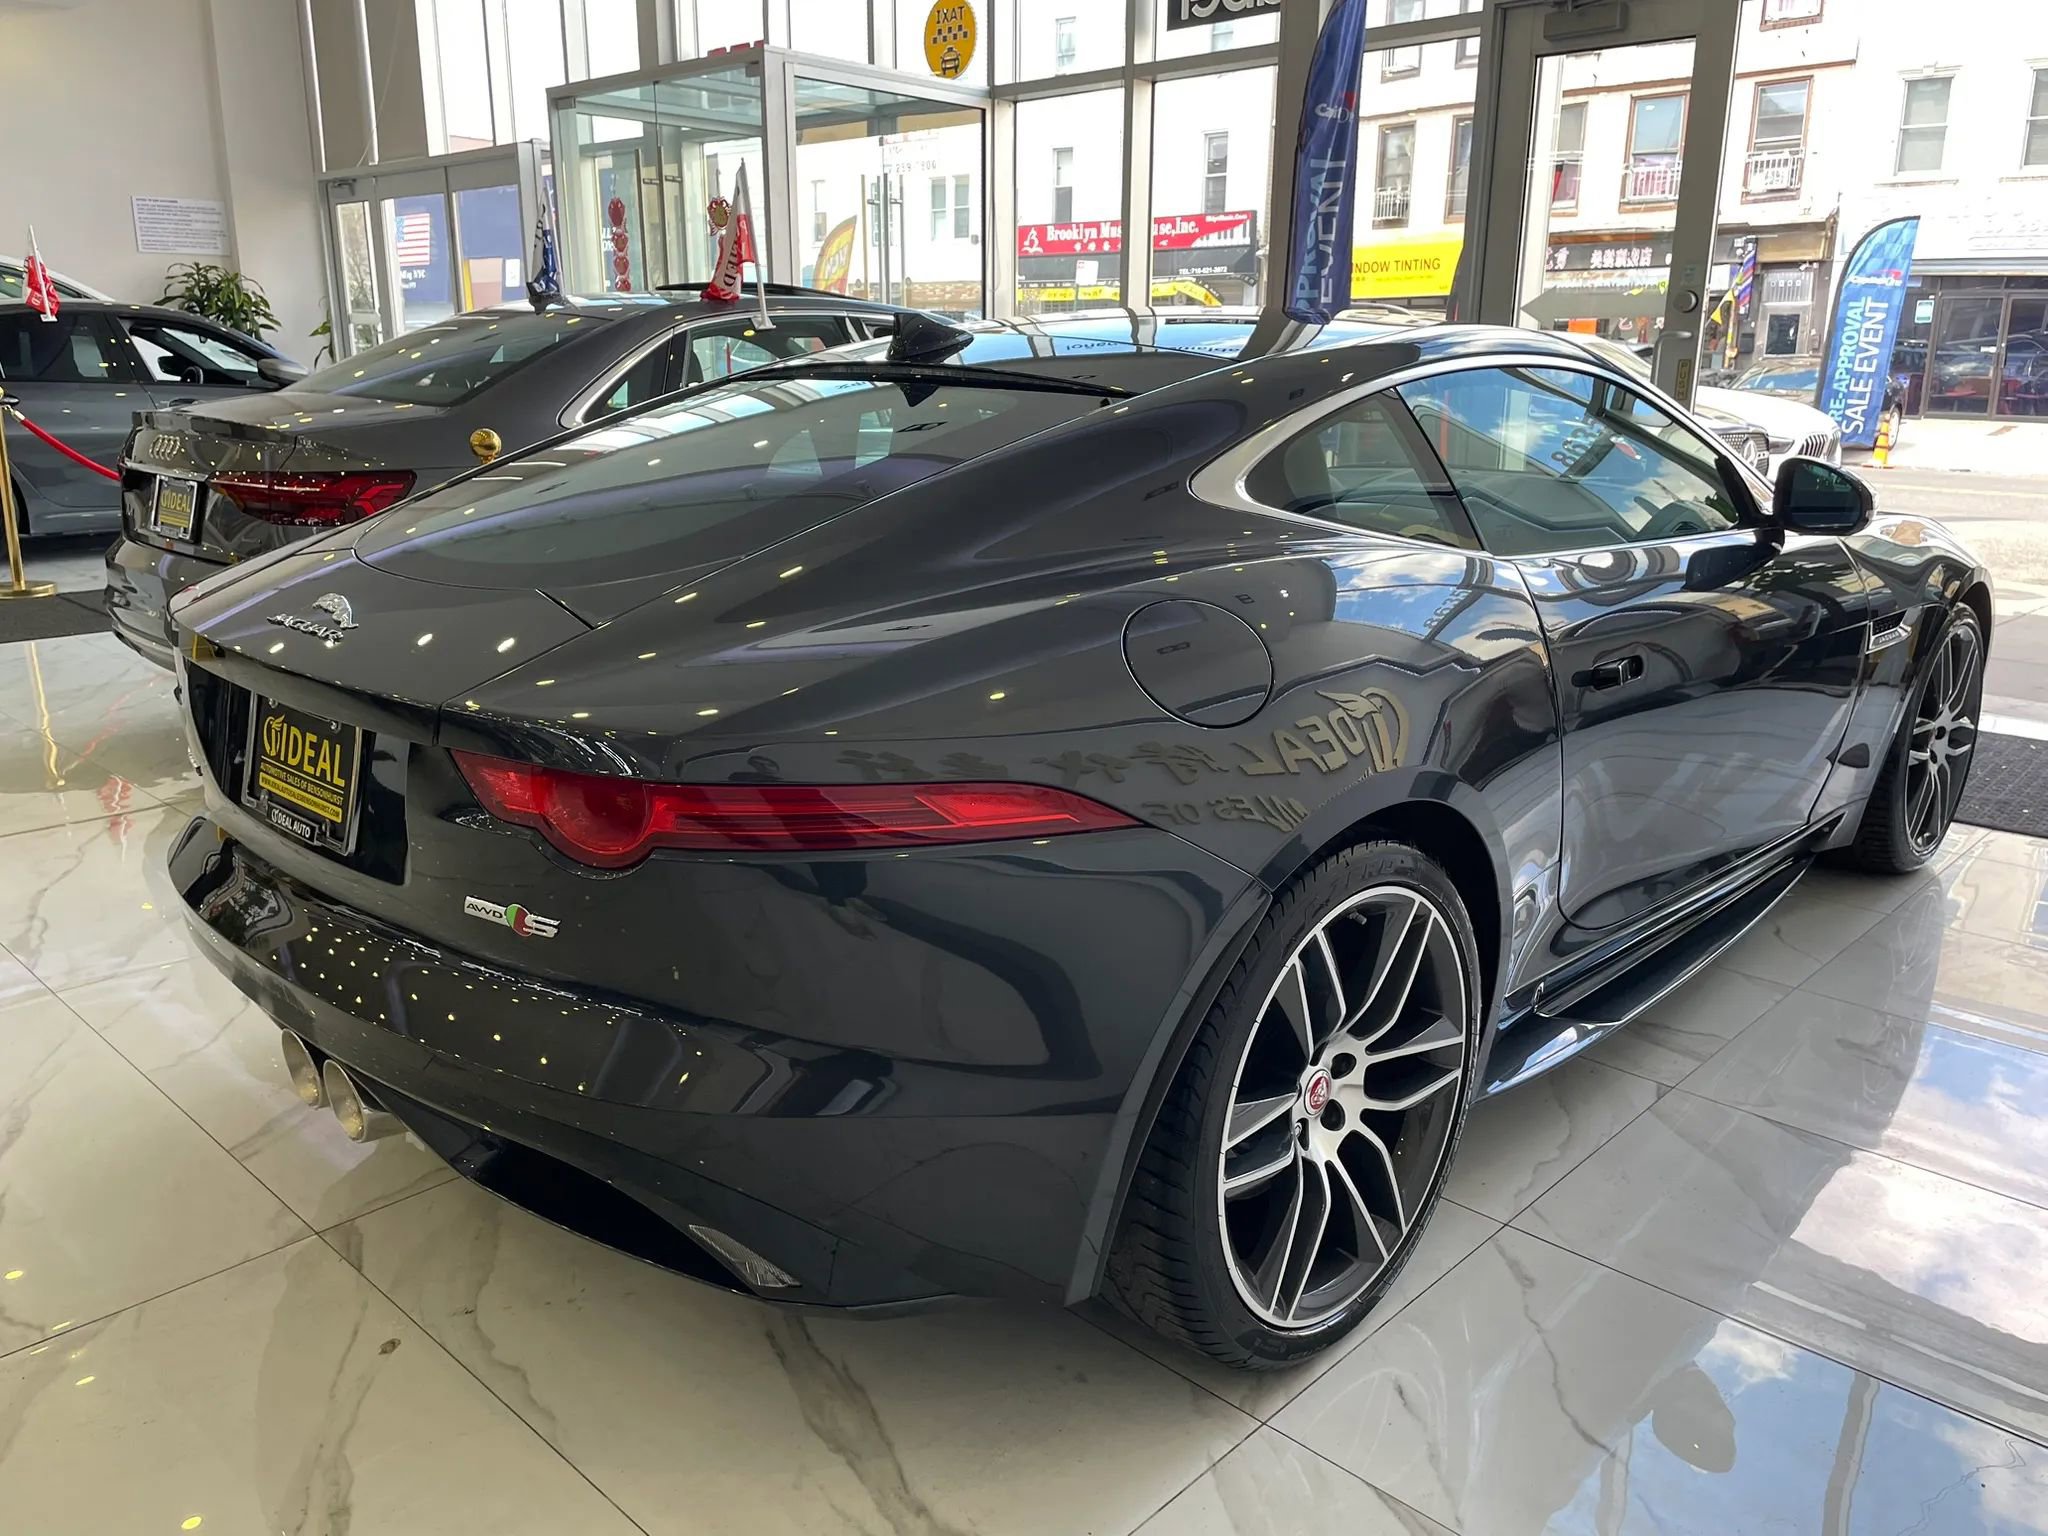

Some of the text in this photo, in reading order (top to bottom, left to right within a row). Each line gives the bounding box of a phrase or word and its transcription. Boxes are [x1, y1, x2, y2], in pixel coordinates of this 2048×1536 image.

[1046, 223, 1098, 243] Brooklyn
[1100, 221, 1121, 238] Mus
[1394, 257, 1440, 272] TINTING
[1828, 297, 1866, 423] RE-APPROVAL
[1841, 296, 1889, 435] SALE EVENT
[168, 490, 191, 513] IDEAL
[280, 722, 346, 787] IDEAL
[292, 818, 311, 838] AUTO
[466, 903, 561, 938] AWD S
